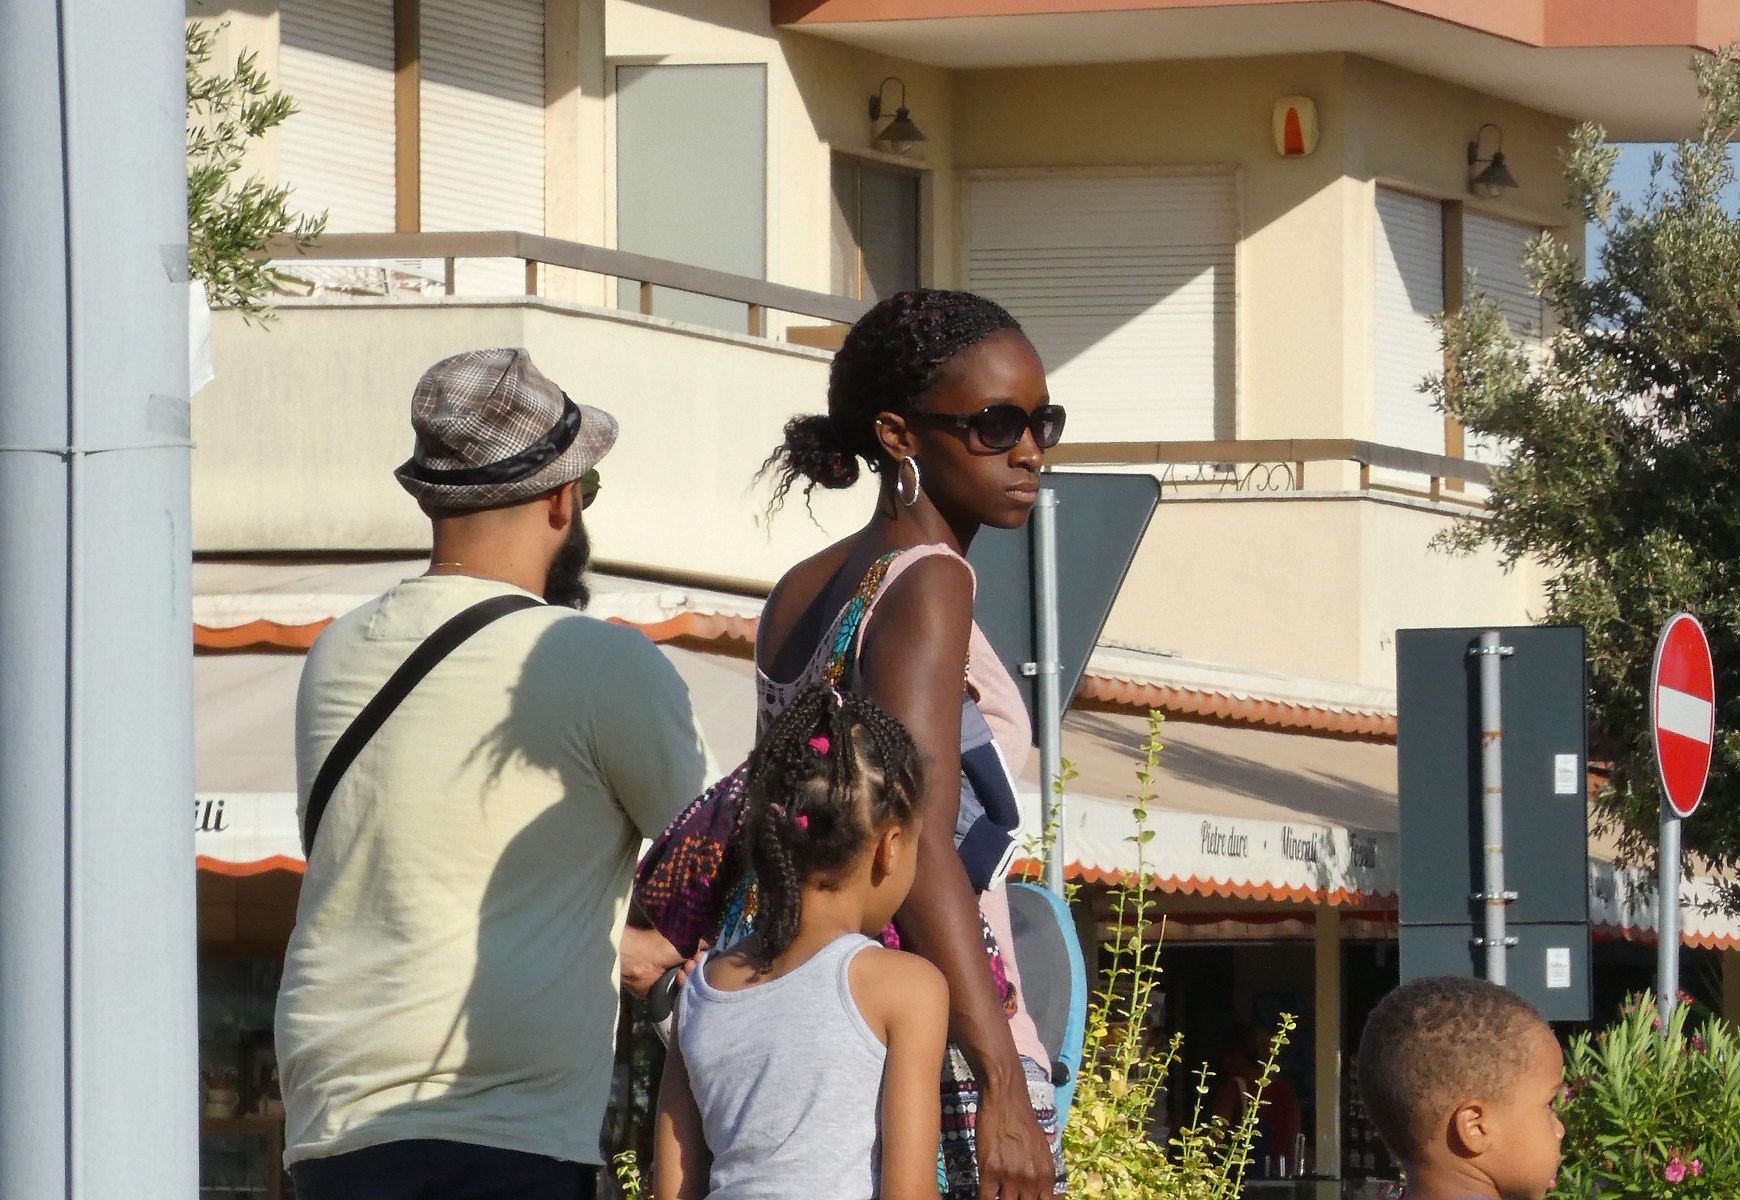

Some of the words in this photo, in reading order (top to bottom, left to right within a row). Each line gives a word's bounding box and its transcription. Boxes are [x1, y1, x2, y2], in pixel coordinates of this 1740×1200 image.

[1201, 820, 1226, 857] Pietre
[1227, 825, 1249, 858] dure
[1281, 825, 1318, 863] Minerali
